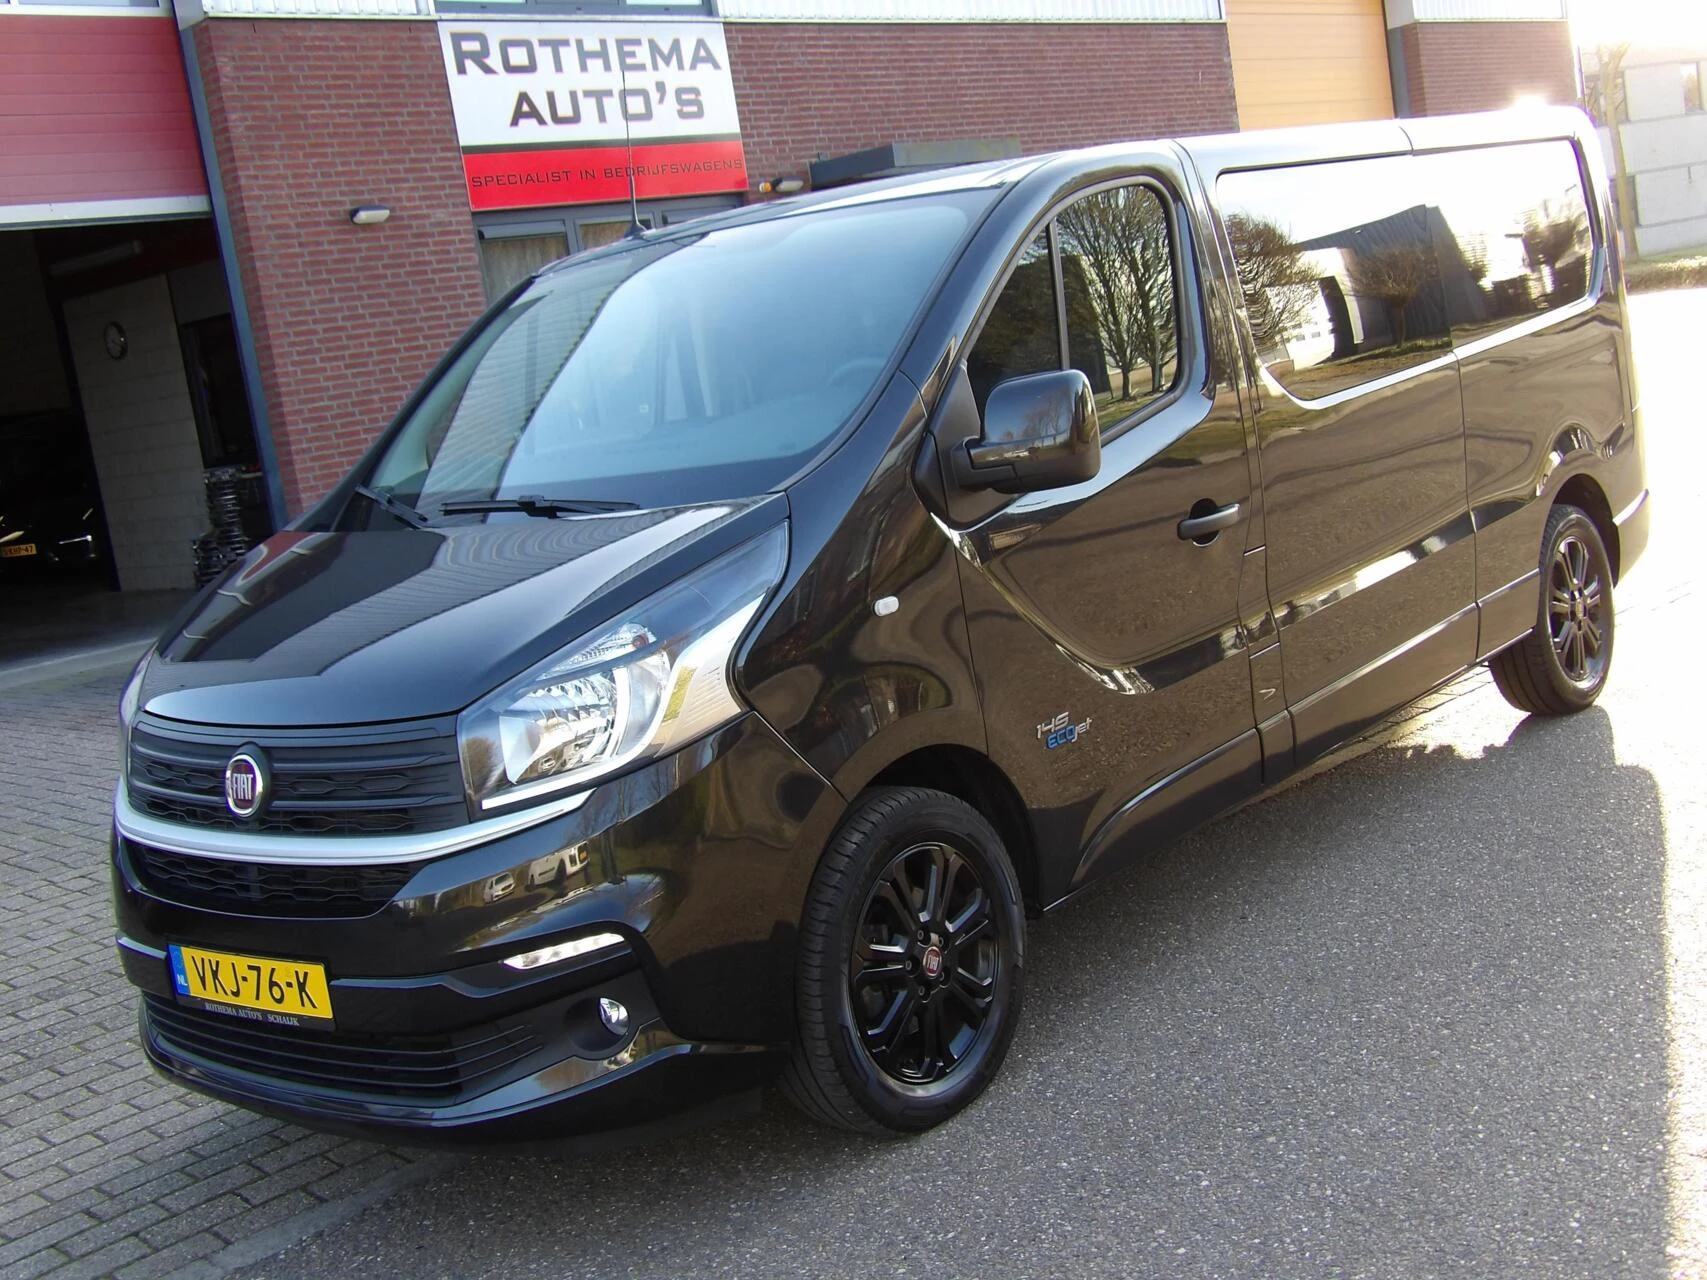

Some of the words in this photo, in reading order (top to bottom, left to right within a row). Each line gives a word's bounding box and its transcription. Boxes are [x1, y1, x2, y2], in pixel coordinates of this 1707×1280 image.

[449, 32, 722, 75] ROTHEMA
[509, 81, 705, 127] AUTO'S
[471, 169, 571, 188] SPECIALIST
[580, 169, 596, 181] IN
[604, 158, 743, 179] BEDRIJFSWAGENS
[1036, 711, 1069, 738] 145
[232, 773, 254, 800] FIAT
[176, 974, 188, 987] NL
[191, 955, 318, 1009] VKJ-76-K
[204, 1002, 238, 1016] ROTHEMA
[238, 1008, 263, 1021] AUTO'S
